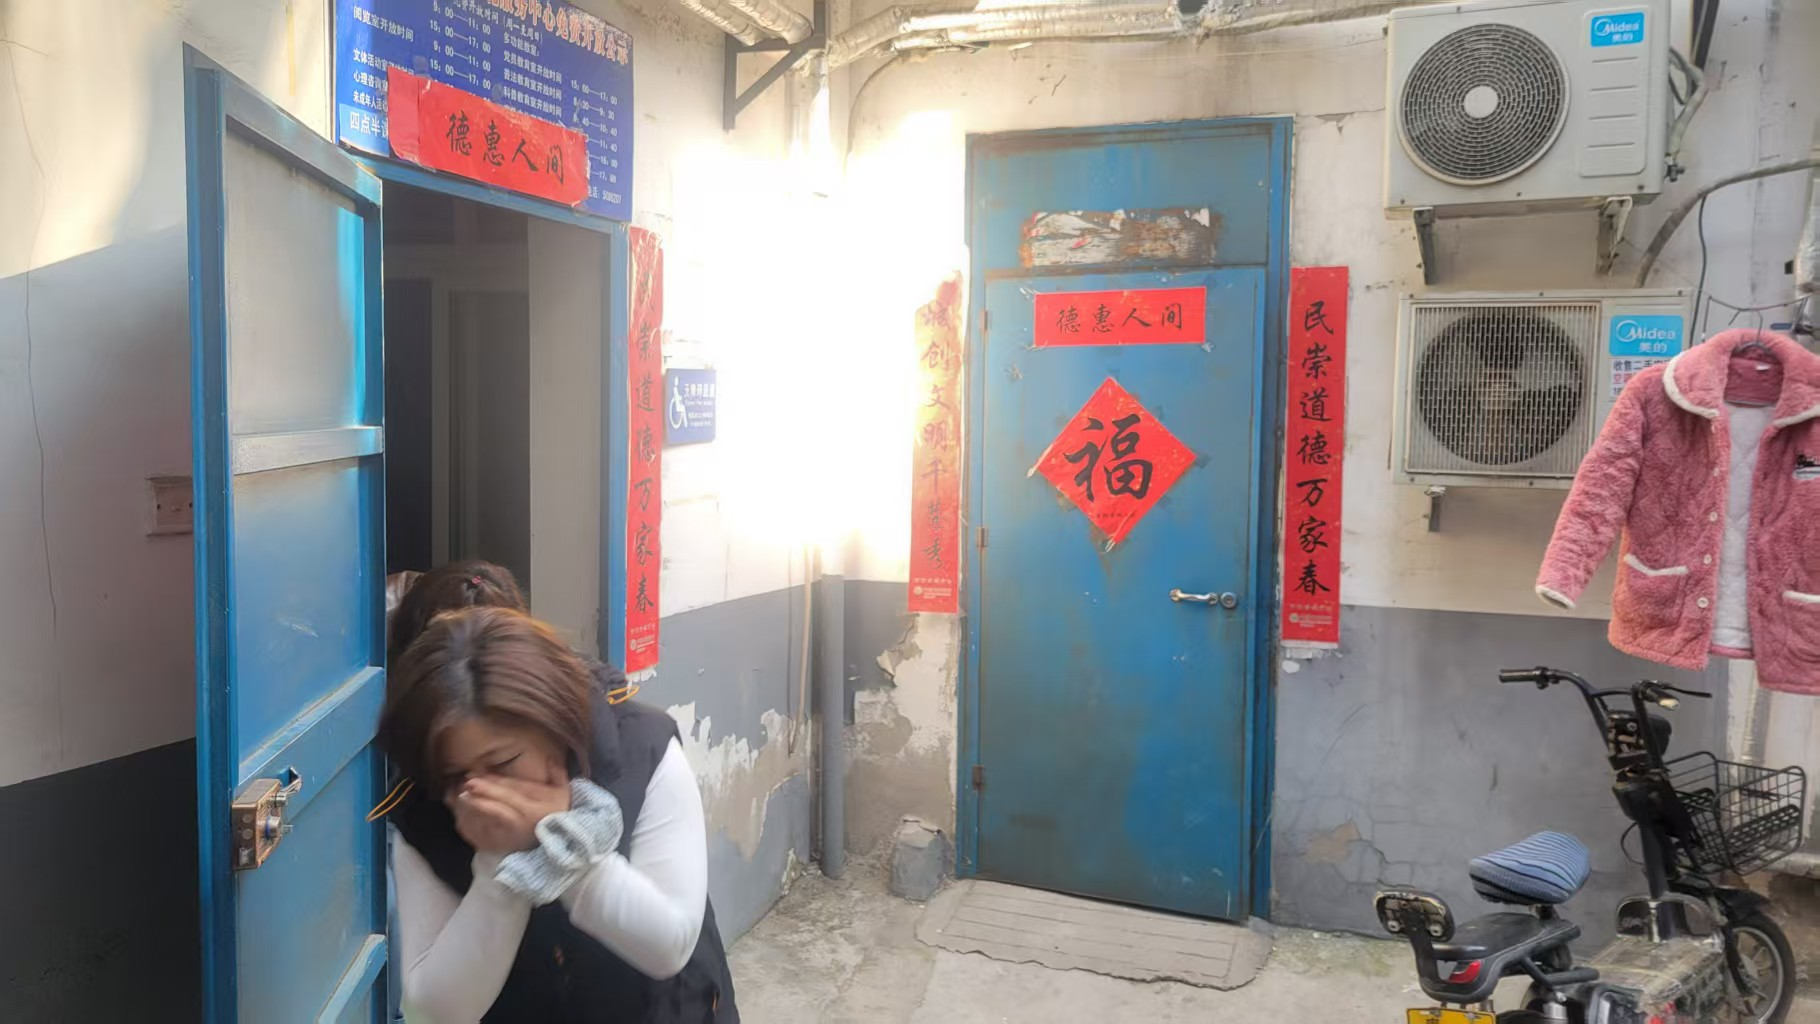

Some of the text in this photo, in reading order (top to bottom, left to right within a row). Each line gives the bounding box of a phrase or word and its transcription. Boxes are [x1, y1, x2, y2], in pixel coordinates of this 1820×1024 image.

[353, 5, 414, 42] 阅览室开放时间
[1595, 19, 1641, 35] Midea
[446, 110, 565, 185] 德惠人间
[1056, 303, 1183, 334] 德惠人间
[1617, 321, 1676, 341] Midea
[1639, 341, 1667, 354] 美的
[1063, 413, 1153, 502] 福
[1295, 301, 1334, 597] 民崇道德万家春
